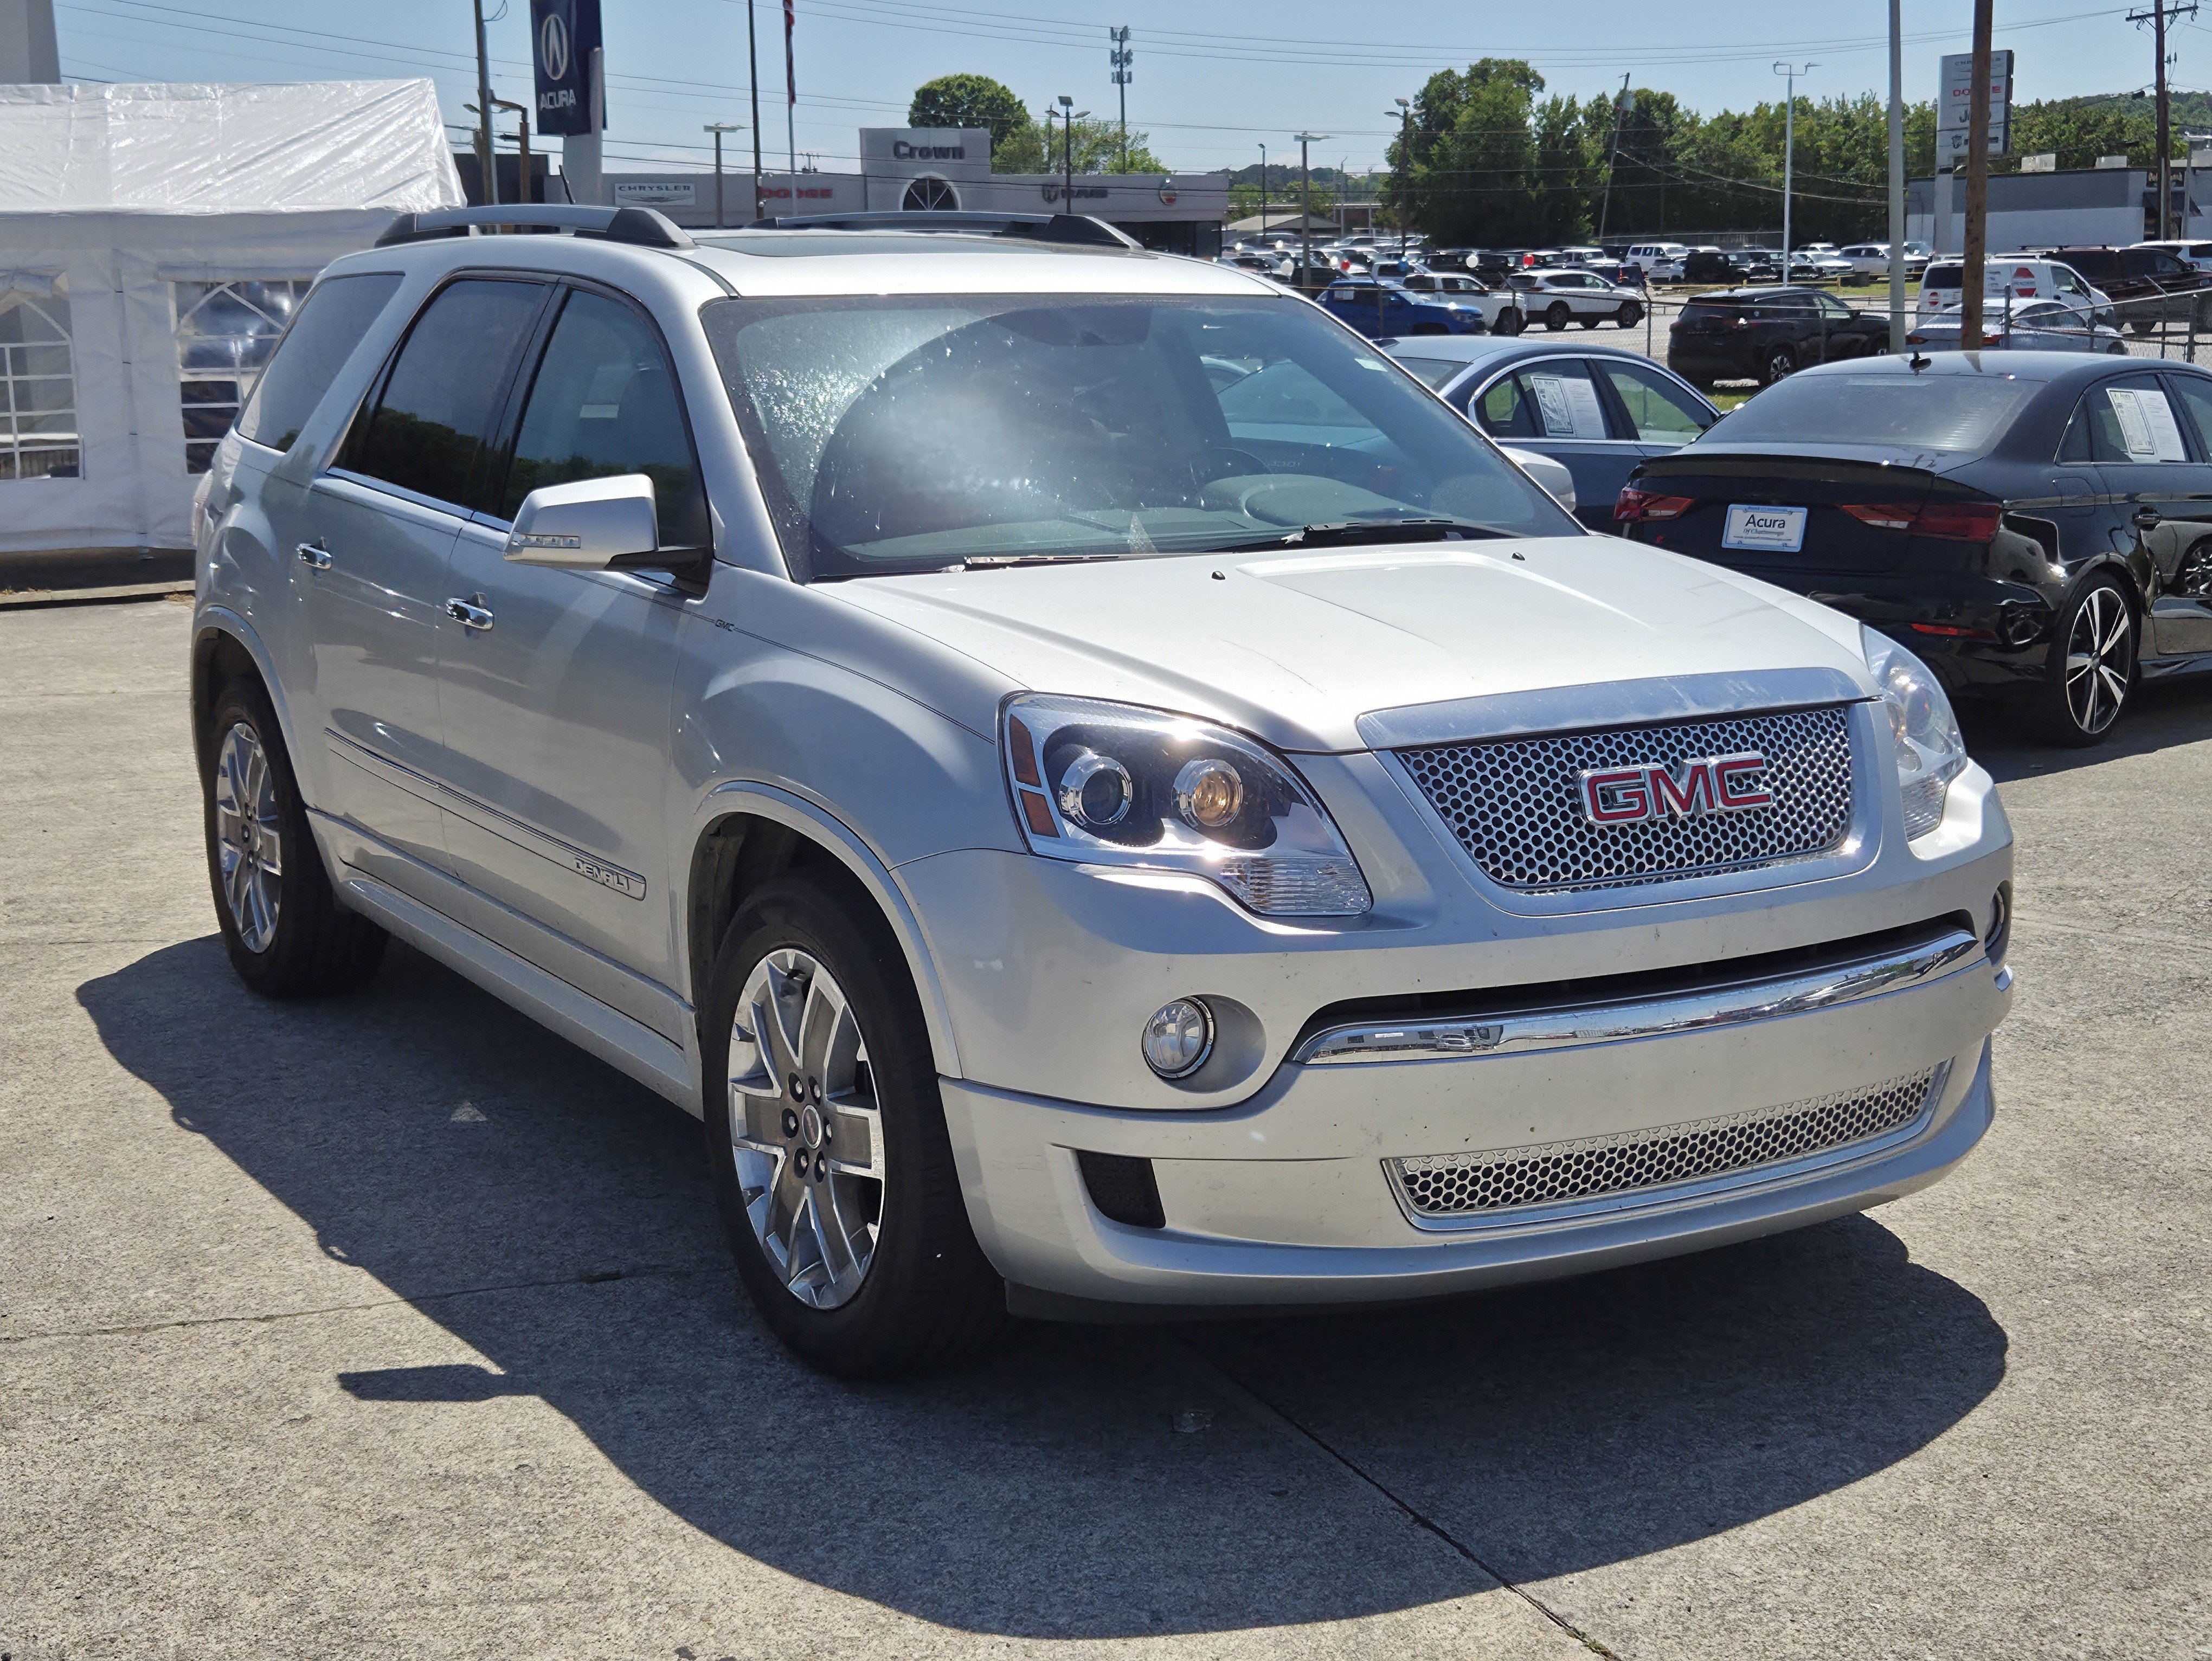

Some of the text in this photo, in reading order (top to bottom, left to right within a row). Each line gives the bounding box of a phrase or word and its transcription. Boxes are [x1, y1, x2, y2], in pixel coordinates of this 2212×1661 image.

[541, 89, 576, 111] ACURA
[893, 140, 966, 160] Crown
[1745, 514, 1786, 529] Acura
[1579, 751, 1774, 826] GMC
[574, 857, 629, 890] DENALI
